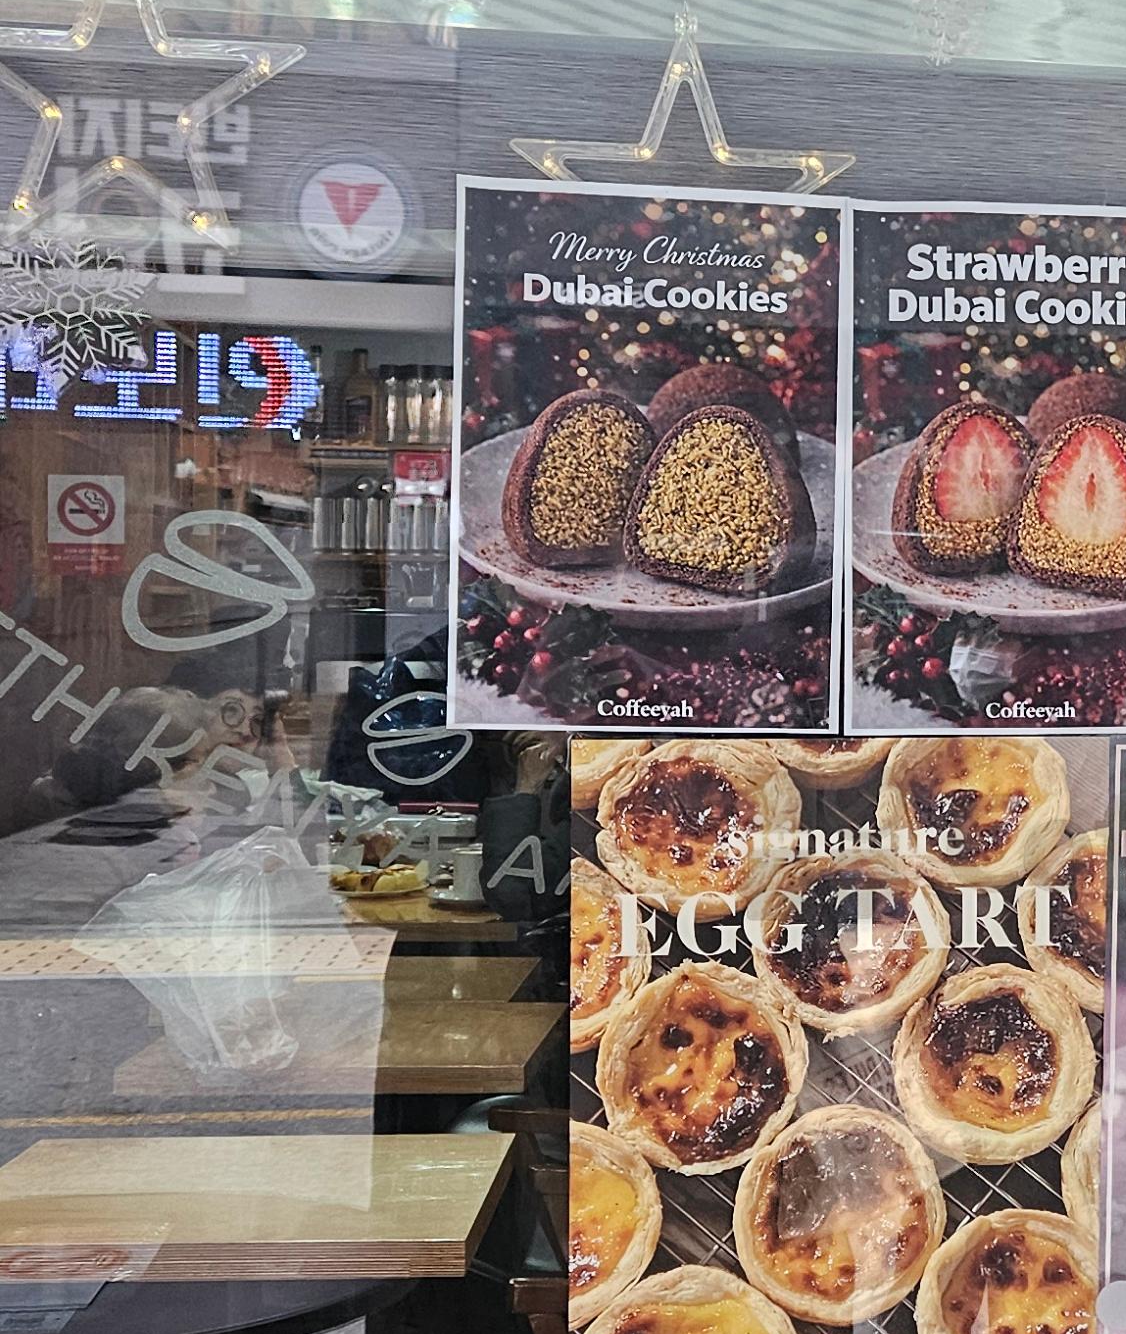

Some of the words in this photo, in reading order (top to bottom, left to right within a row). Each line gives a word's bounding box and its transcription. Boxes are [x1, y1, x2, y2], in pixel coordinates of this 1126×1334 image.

[547, 230, 637, 271] Merry
[642, 234, 767, 270] Christmas
[522, 271, 636, 309] Dubai
[643, 276, 789, 315] Cookies
[888, 286, 1006, 325] Dubai
[596, 697, 694, 721] Coffeeyah
[985, 699, 1077, 721] Coffeeyah
[728, 818, 966, 863] signature
[615, 886, 807, 958] EGG
[834, 880, 1072, 952] TART
